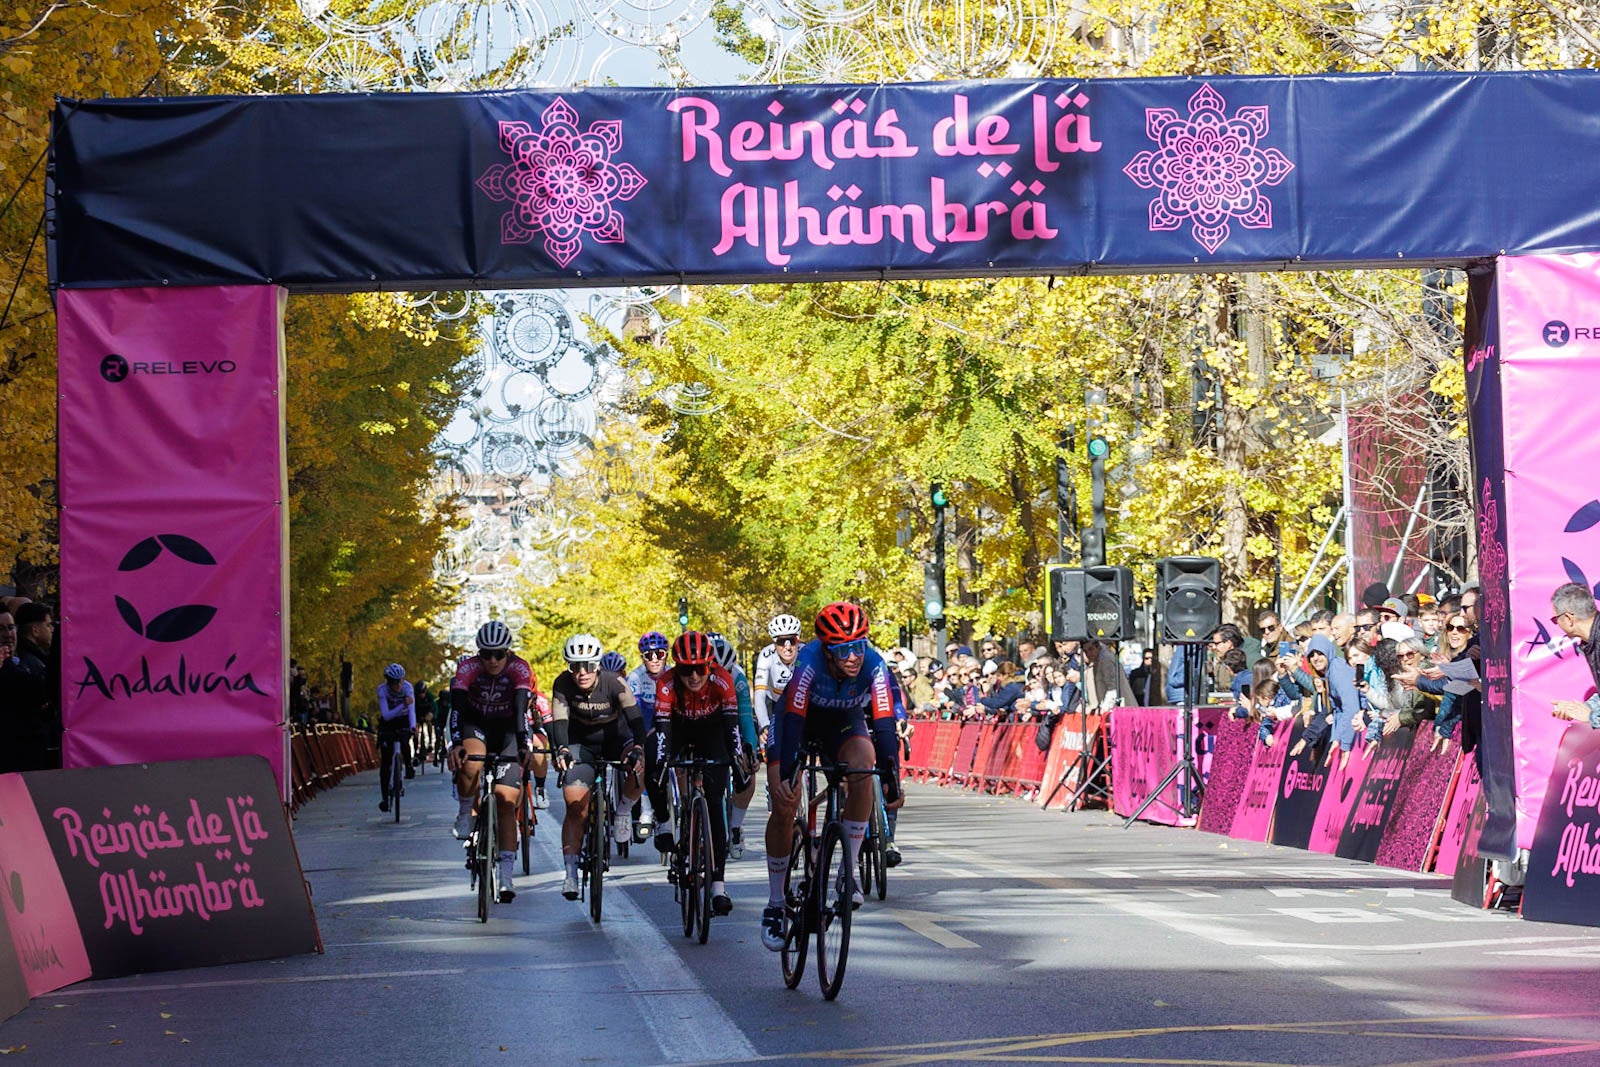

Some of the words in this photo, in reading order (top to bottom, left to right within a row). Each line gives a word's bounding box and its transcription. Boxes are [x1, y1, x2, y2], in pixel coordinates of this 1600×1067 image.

[132, 360, 237, 375] RELEVO
[1087, 612, 1119, 621] TORNADO
[73, 653, 271, 701] Andalucía
[793, 664, 816, 710] CERATIZIT
[871, 666, 891, 712] CERATIZIT
